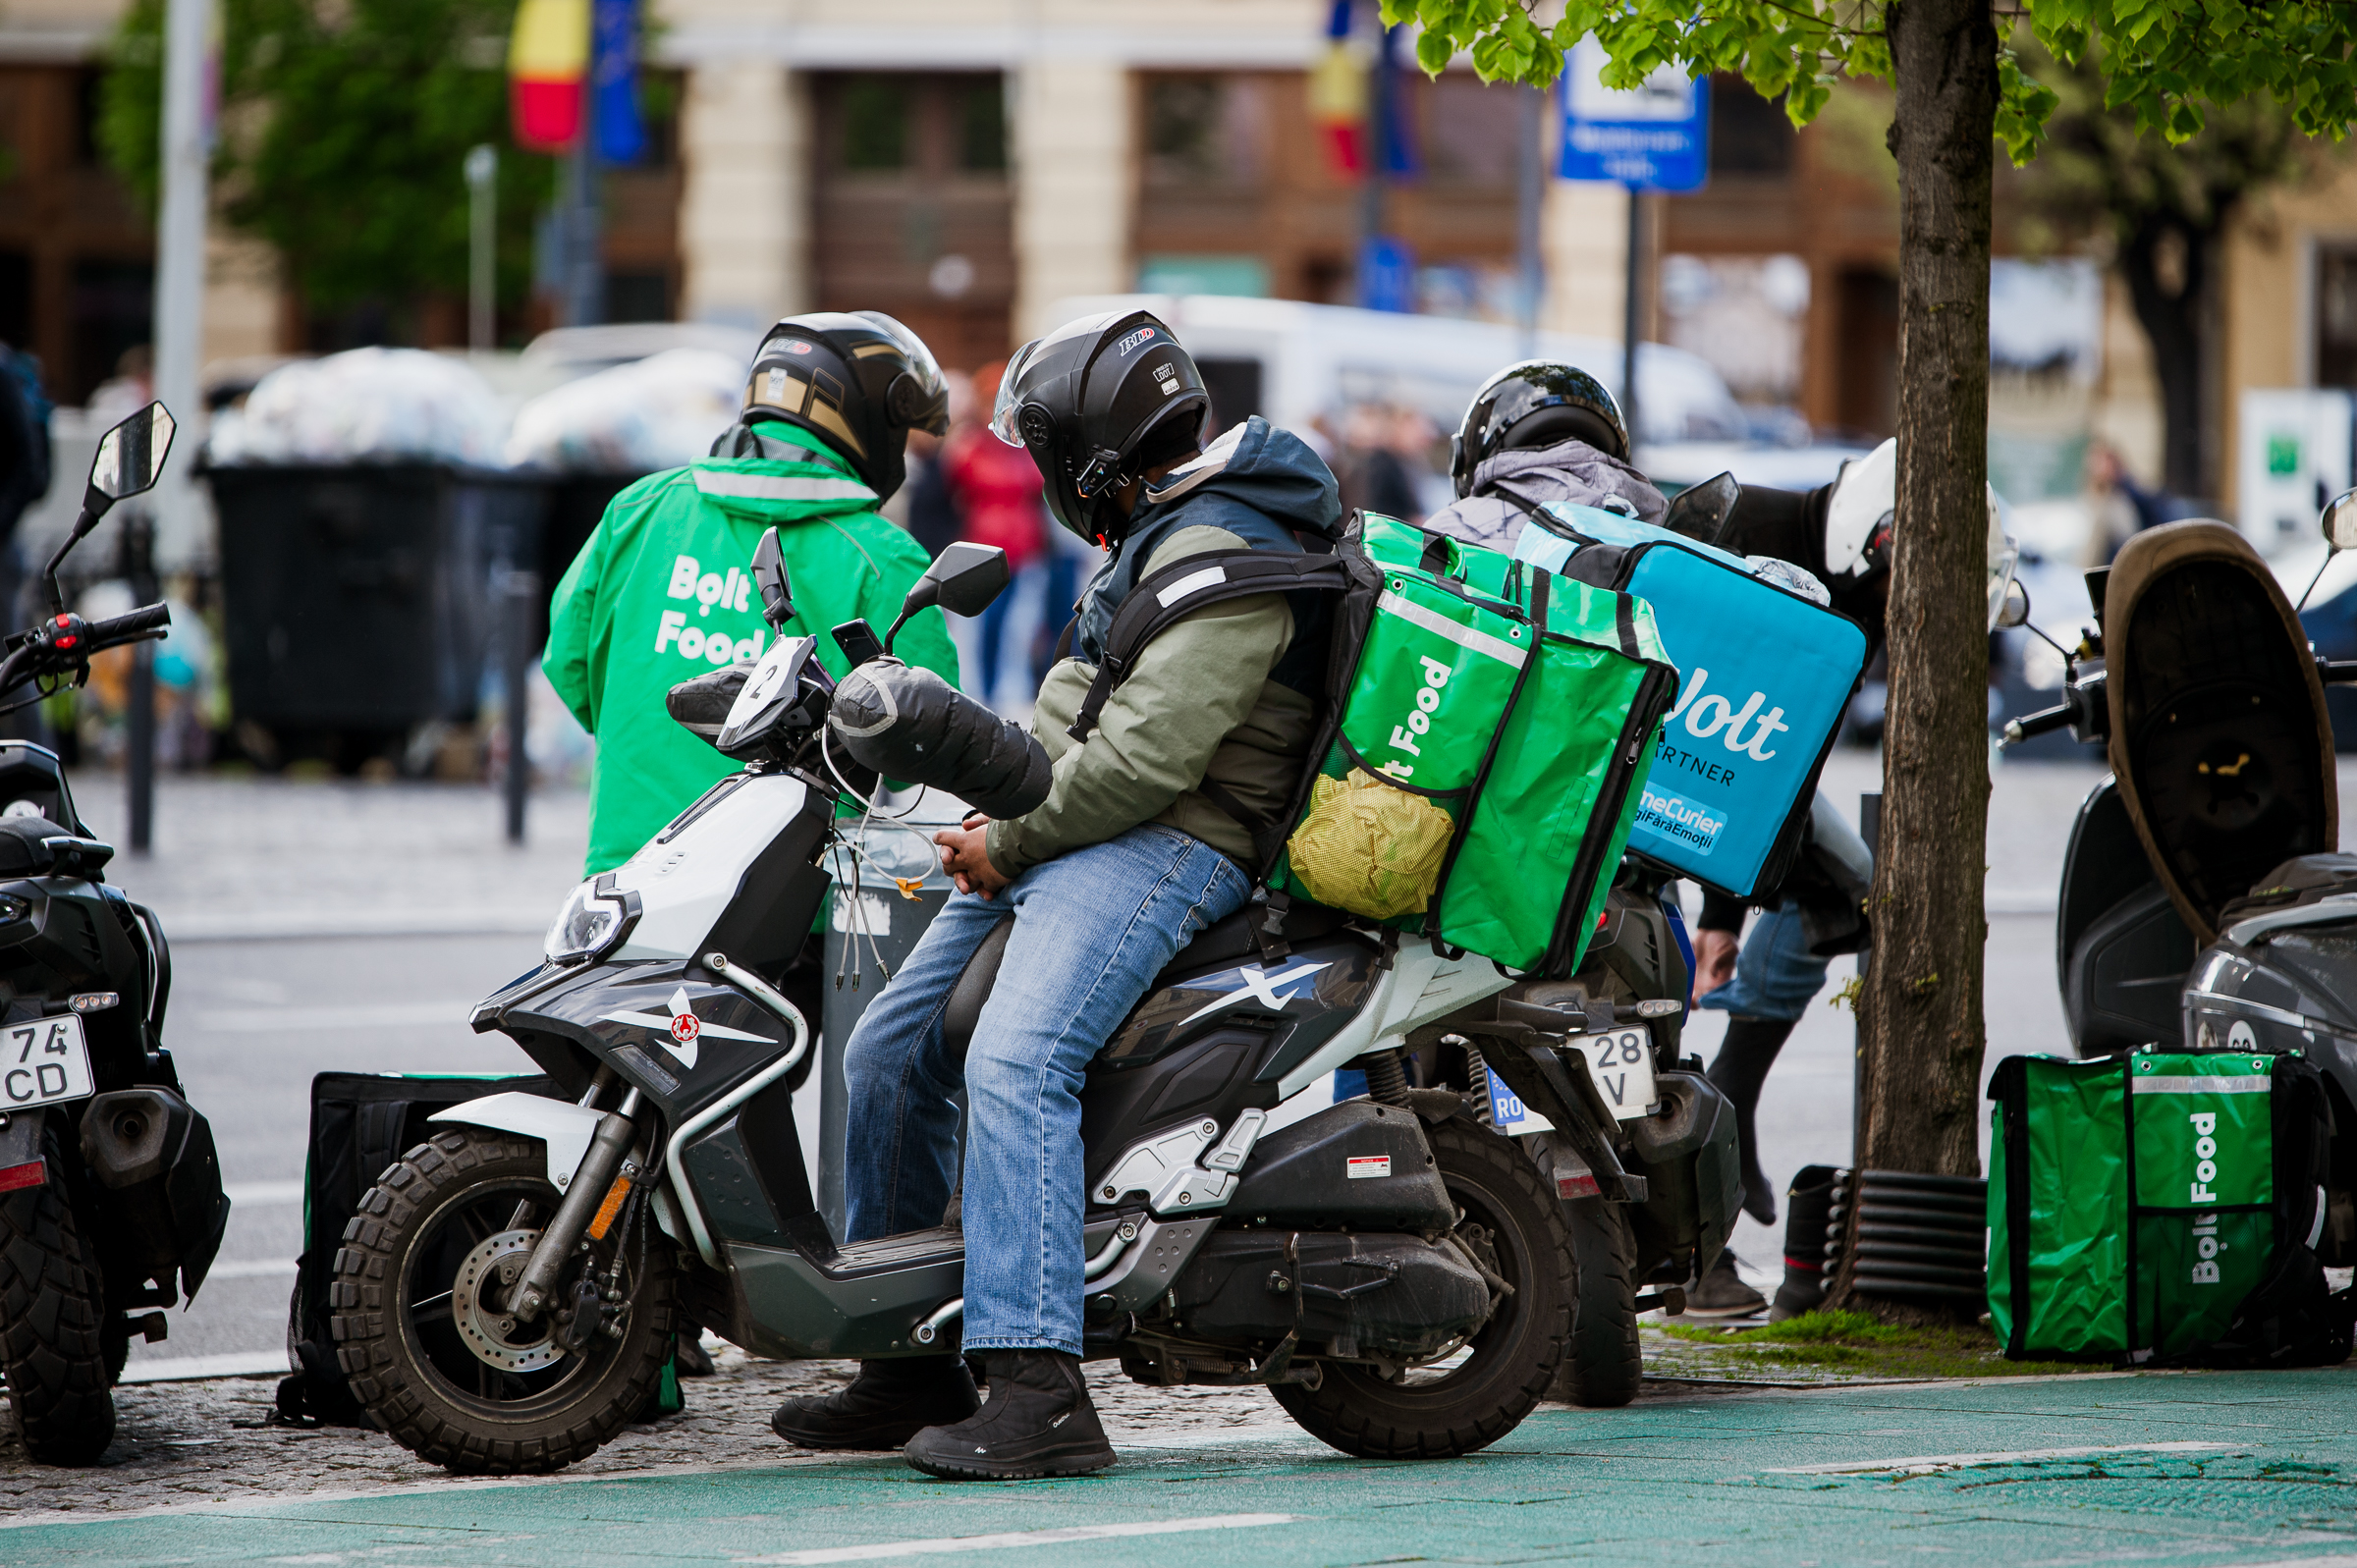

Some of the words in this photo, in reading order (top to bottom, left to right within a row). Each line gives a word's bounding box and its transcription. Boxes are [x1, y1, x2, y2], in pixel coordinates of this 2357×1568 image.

[667, 554, 751, 618] Bolt
[654, 609, 765, 666] Food
[1389, 655, 1453, 757] Food
[13, 1023, 68, 1063] 74
[1595, 1033, 1641, 1068] 28
[5, 1062, 68, 1102] CD
[1496, 1096, 1522, 1119] RO
[2190, 1111, 2218, 1204] Food
